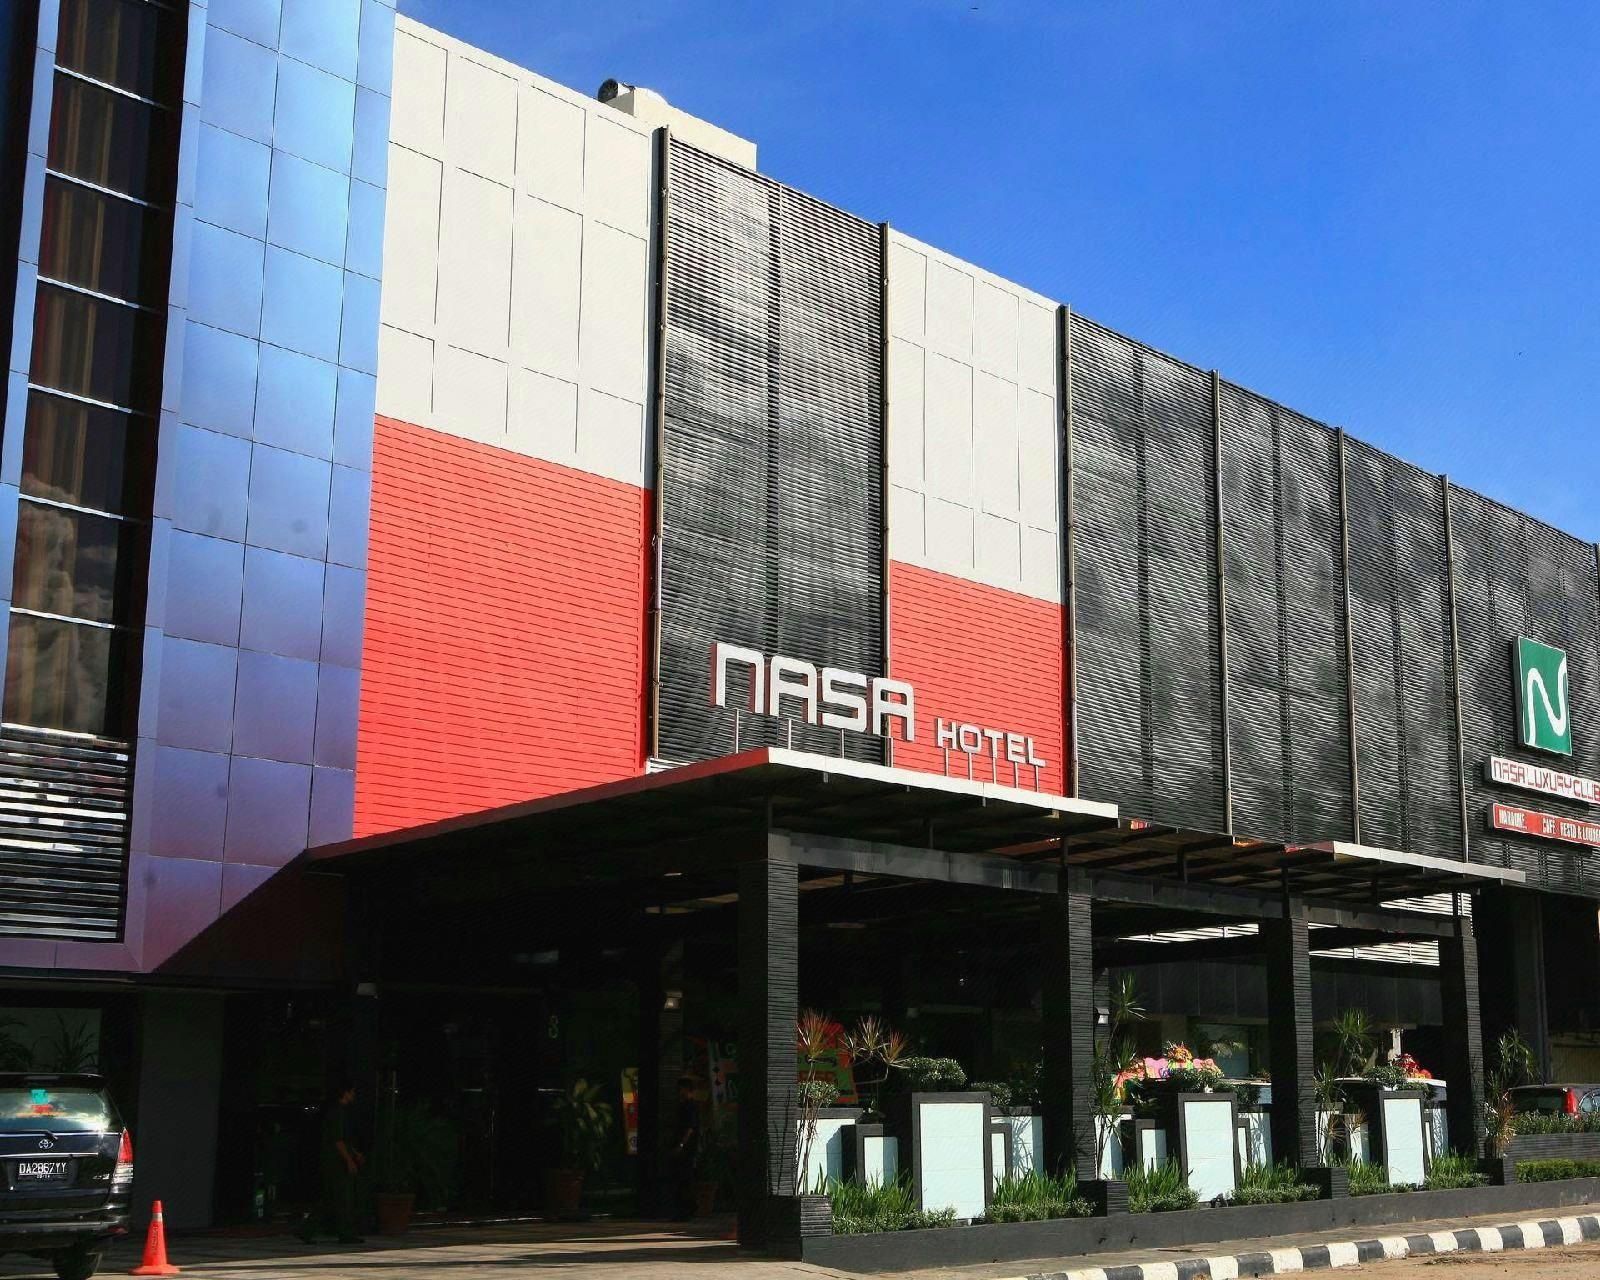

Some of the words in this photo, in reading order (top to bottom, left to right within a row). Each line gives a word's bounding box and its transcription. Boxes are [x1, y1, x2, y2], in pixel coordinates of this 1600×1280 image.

[711, 642, 914, 741] NASA
[935, 717, 1046, 768] HOTEL
[1493, 759, 1526, 785] NASA
[1527, 767, 1572, 794] LUXURY
